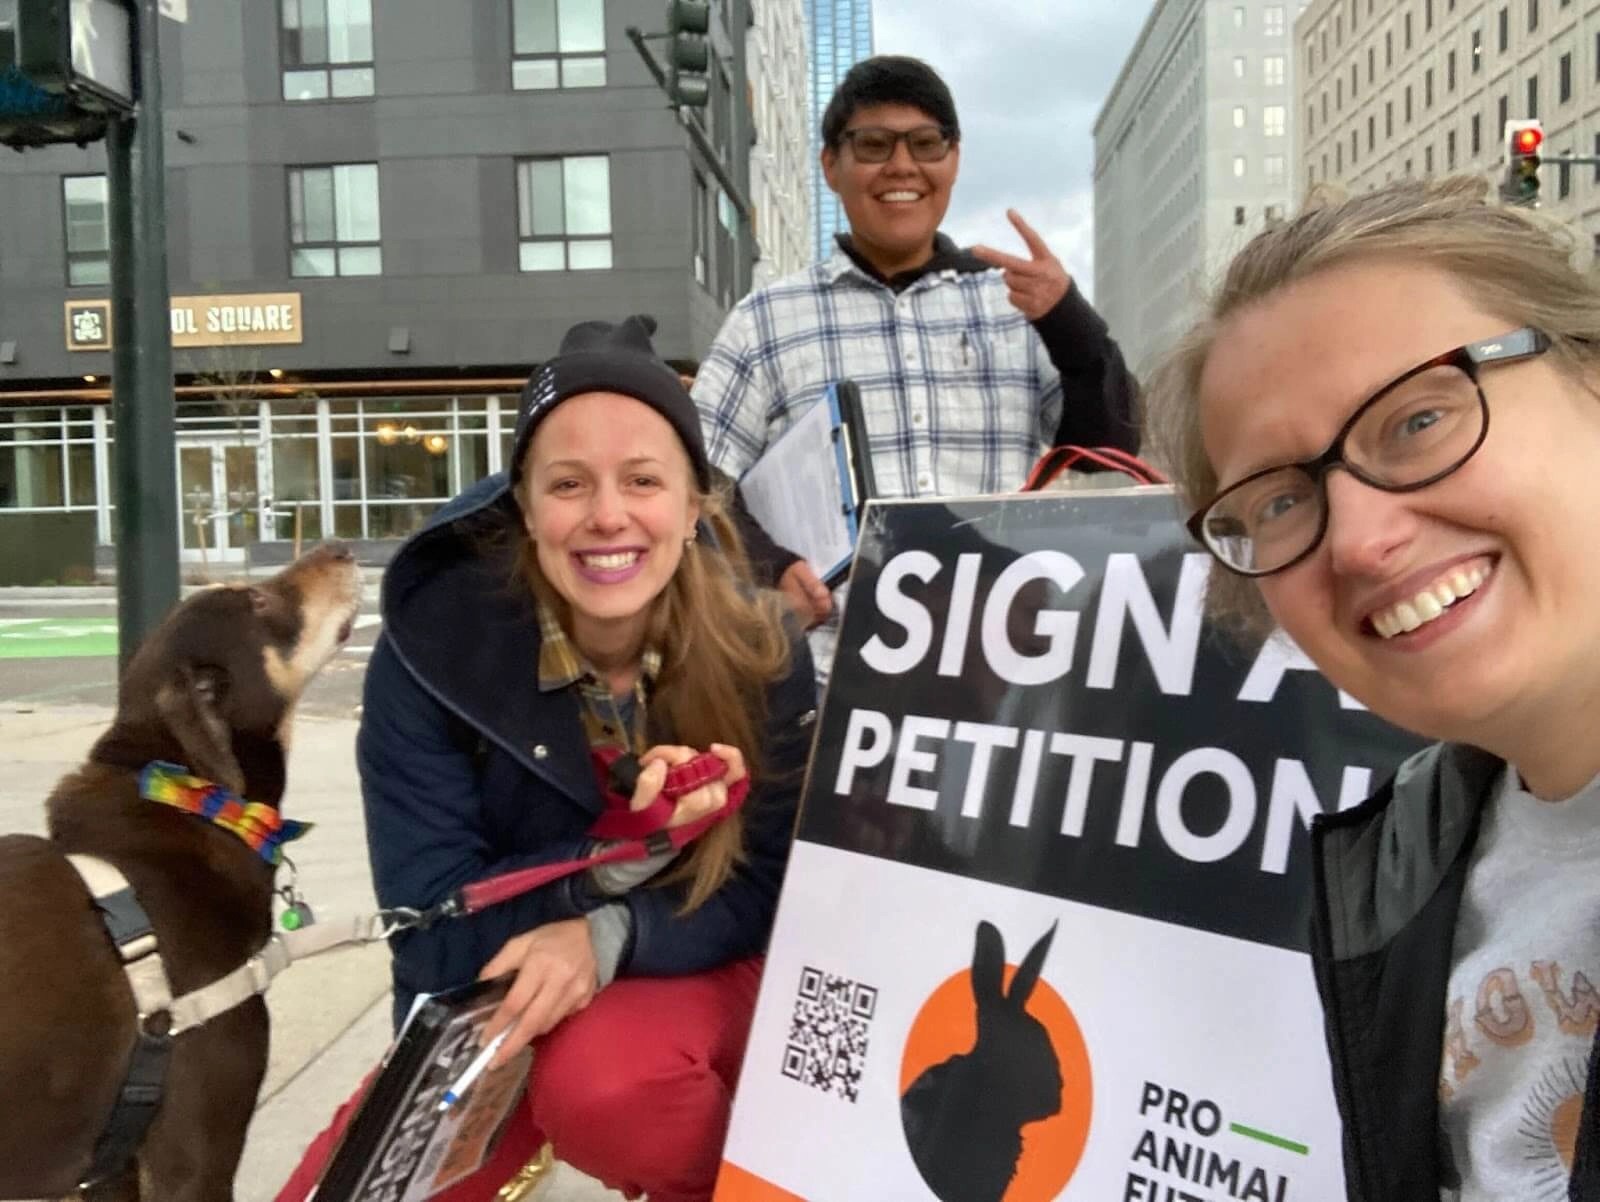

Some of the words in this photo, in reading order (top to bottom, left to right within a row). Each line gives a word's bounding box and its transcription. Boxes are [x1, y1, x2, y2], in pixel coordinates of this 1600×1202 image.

[207, 304, 293, 333] SQUARE
[859, 549, 1214, 695] SIGN
[834, 708, 1373, 875] PETITION
[1139, 1081, 1222, 1137] PRO
